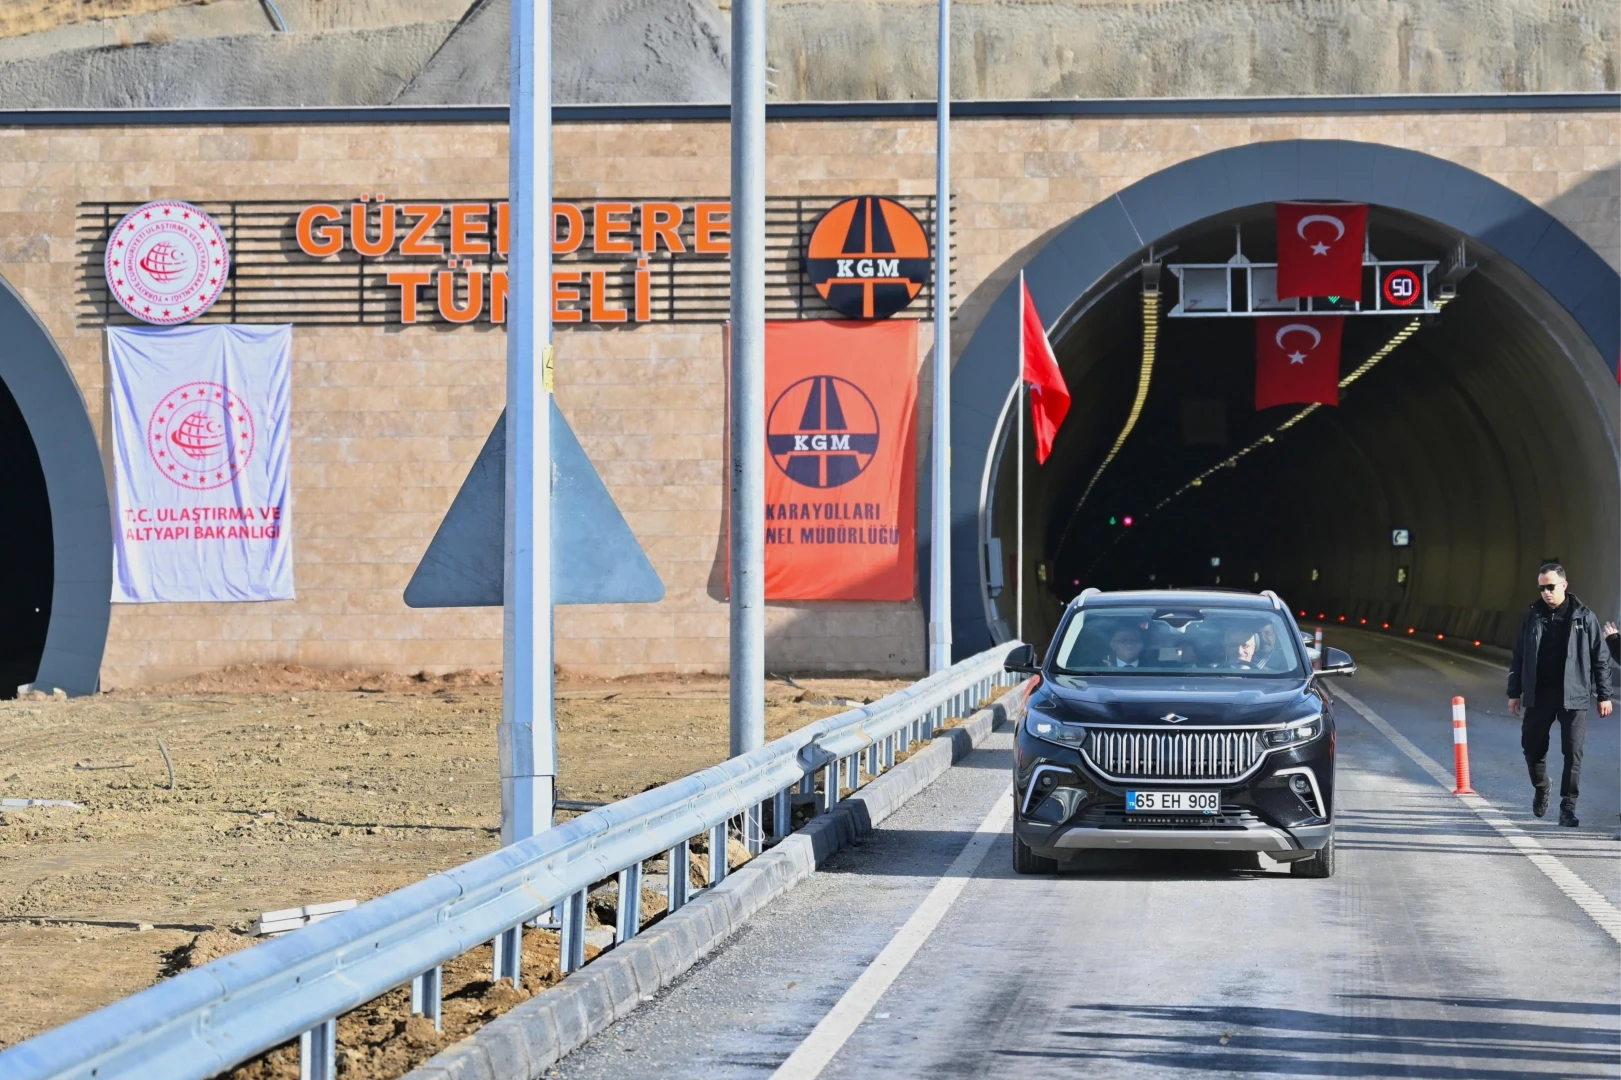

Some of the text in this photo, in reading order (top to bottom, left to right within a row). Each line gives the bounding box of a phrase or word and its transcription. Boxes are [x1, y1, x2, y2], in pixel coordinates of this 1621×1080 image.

[144, 223, 188, 234] ULAŞTIRMA
[187, 231, 197, 241] VE
[194, 240, 206, 271] ALTYAPI
[836, 259, 900, 277] KGM
[1392, 278, 1412, 296] 50
[794, 434, 850, 451] KGM
[125, 506, 281, 525] T.C. ULAŞTIRMA VE
[766, 503, 880, 521] KARAYOLLARI
[126, 523, 281, 541] ALTYAPI BAKANLIĞI
[765, 524, 900, 545] NEL MÜDÜRLÜĞÜ
[1136, 794, 1217, 809] 65 EH 908
